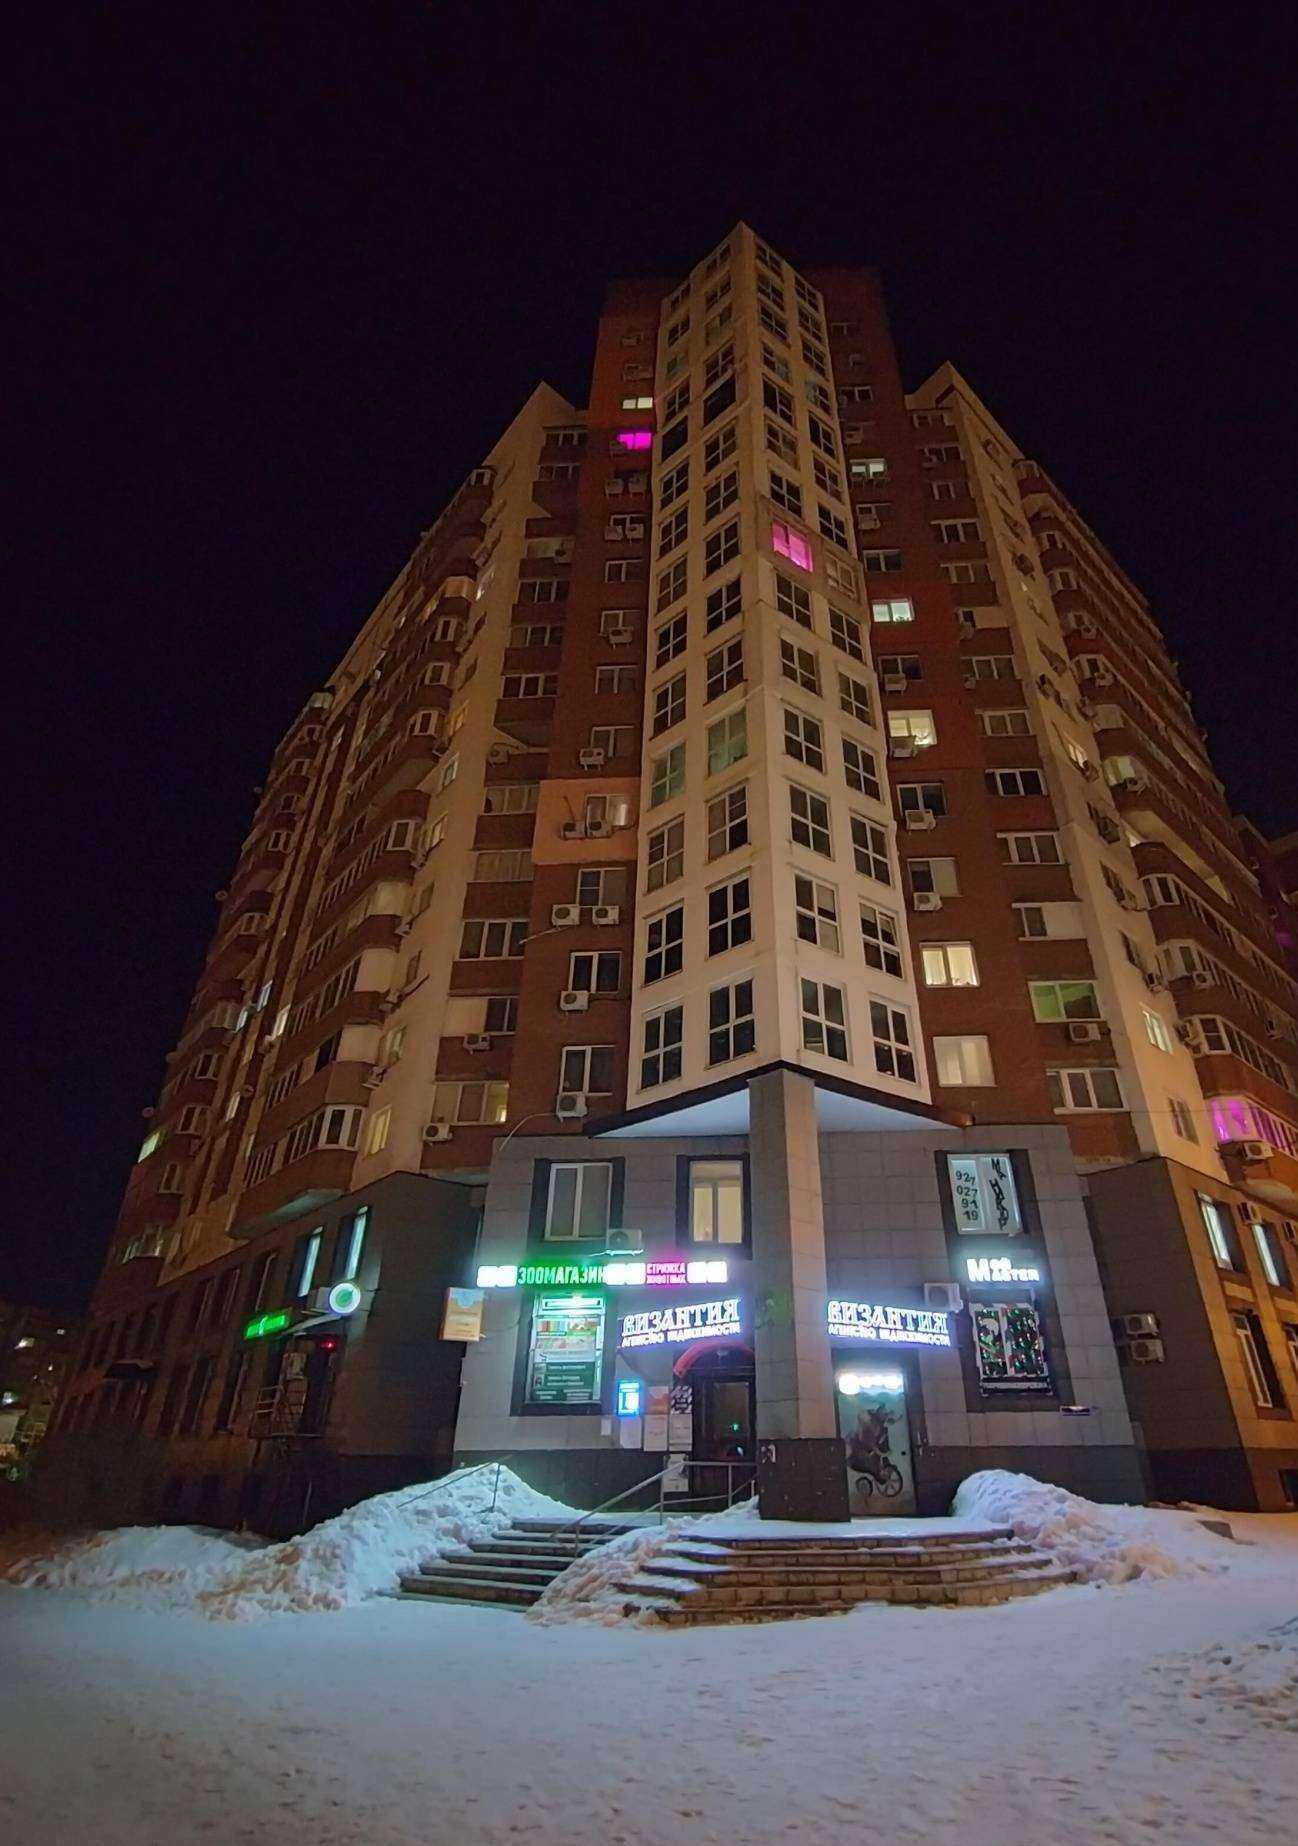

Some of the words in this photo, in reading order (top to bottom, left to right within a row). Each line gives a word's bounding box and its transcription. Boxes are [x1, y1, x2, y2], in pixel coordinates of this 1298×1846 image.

[956, 1171, 975, 1185] 927
[957, 1186, 978, 1198] 027
[518, 1266, 607, 1285] ЗООМАГАЗИН
[647, 1263, 686, 1273] СТРИЖКА
[622, 1299, 740, 1337] ВИЗАНТИЯ
[827, 1301, 948, 1335] ВИЗАНТИЯ
